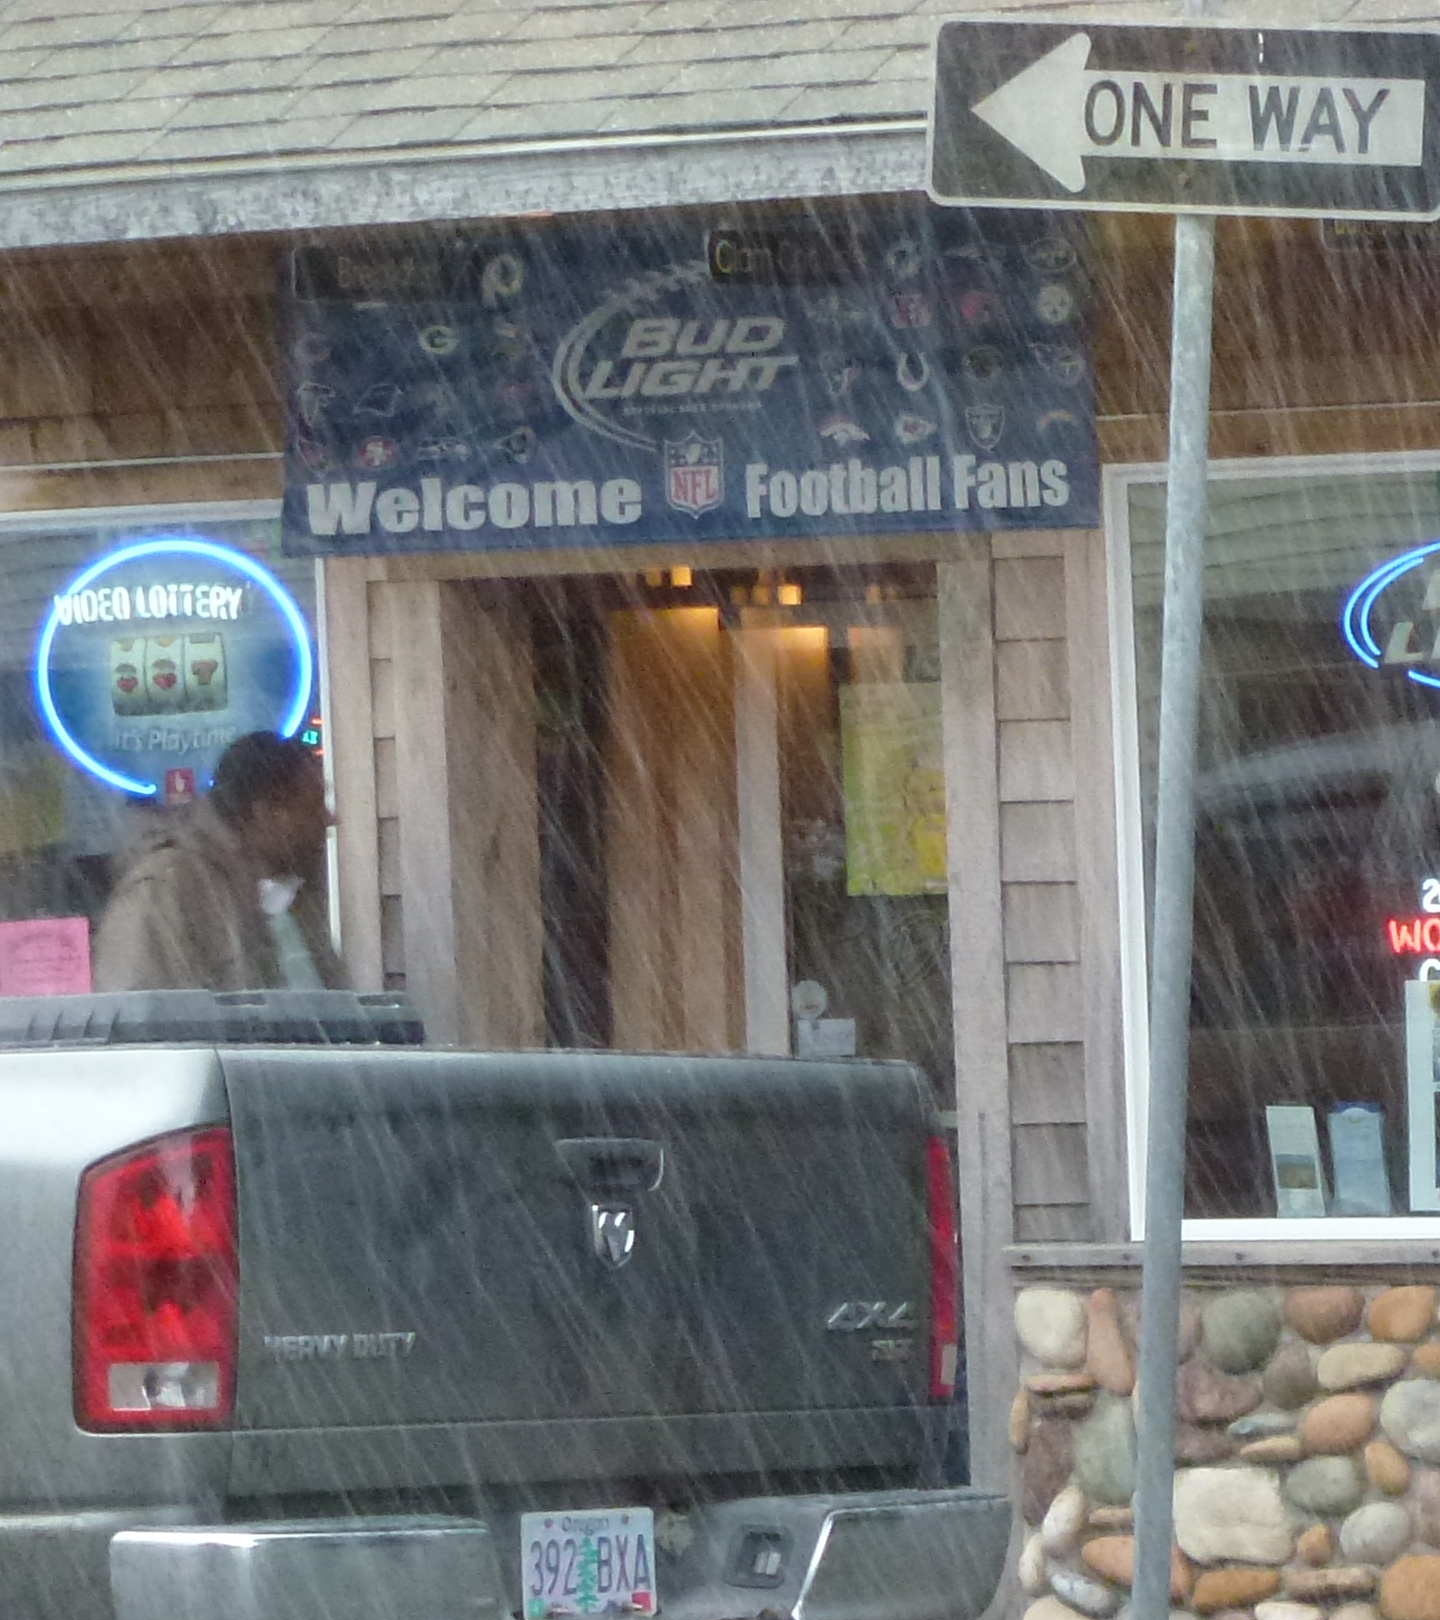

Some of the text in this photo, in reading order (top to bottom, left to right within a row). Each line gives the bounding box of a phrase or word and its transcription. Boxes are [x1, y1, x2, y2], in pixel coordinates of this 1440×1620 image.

[1084, 79, 1391, 155] ONE WAY
[621, 316, 785, 358] BUD
[584, 355, 799, 400] LIGHT
[306, 454, 1071, 536] Welcome Football Fans
[673, 468, 717, 506] NFL
[54, 583, 243, 626] VIDEO LOTTERY
[353, 1331, 416, 1360] DUTY
[530, 1533, 651, 1596] 392 BXA
